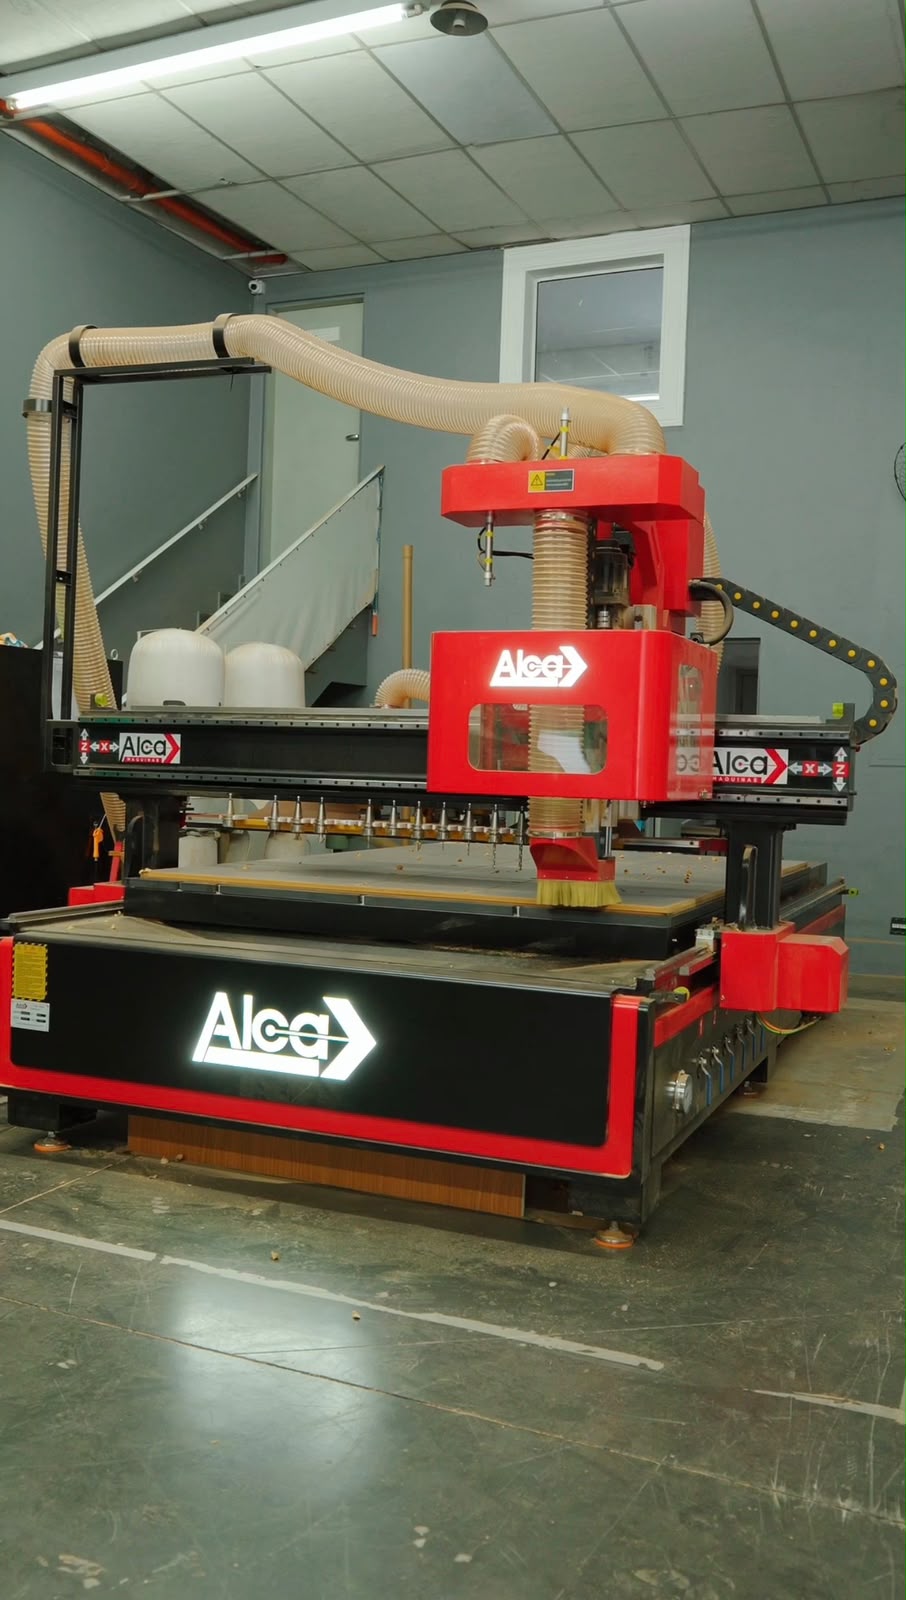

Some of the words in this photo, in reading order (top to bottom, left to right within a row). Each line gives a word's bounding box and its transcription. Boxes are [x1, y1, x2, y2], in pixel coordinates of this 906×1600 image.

[490, 649, 563, 687] Alca
[81, 742, 87, 751] Z
[100, 742, 108, 751] X
[120, 736, 167, 761] Alca
[805, 764, 814, 773] X
[836, 764, 845, 775] Z
[191, 991, 330, 1063] Alca
